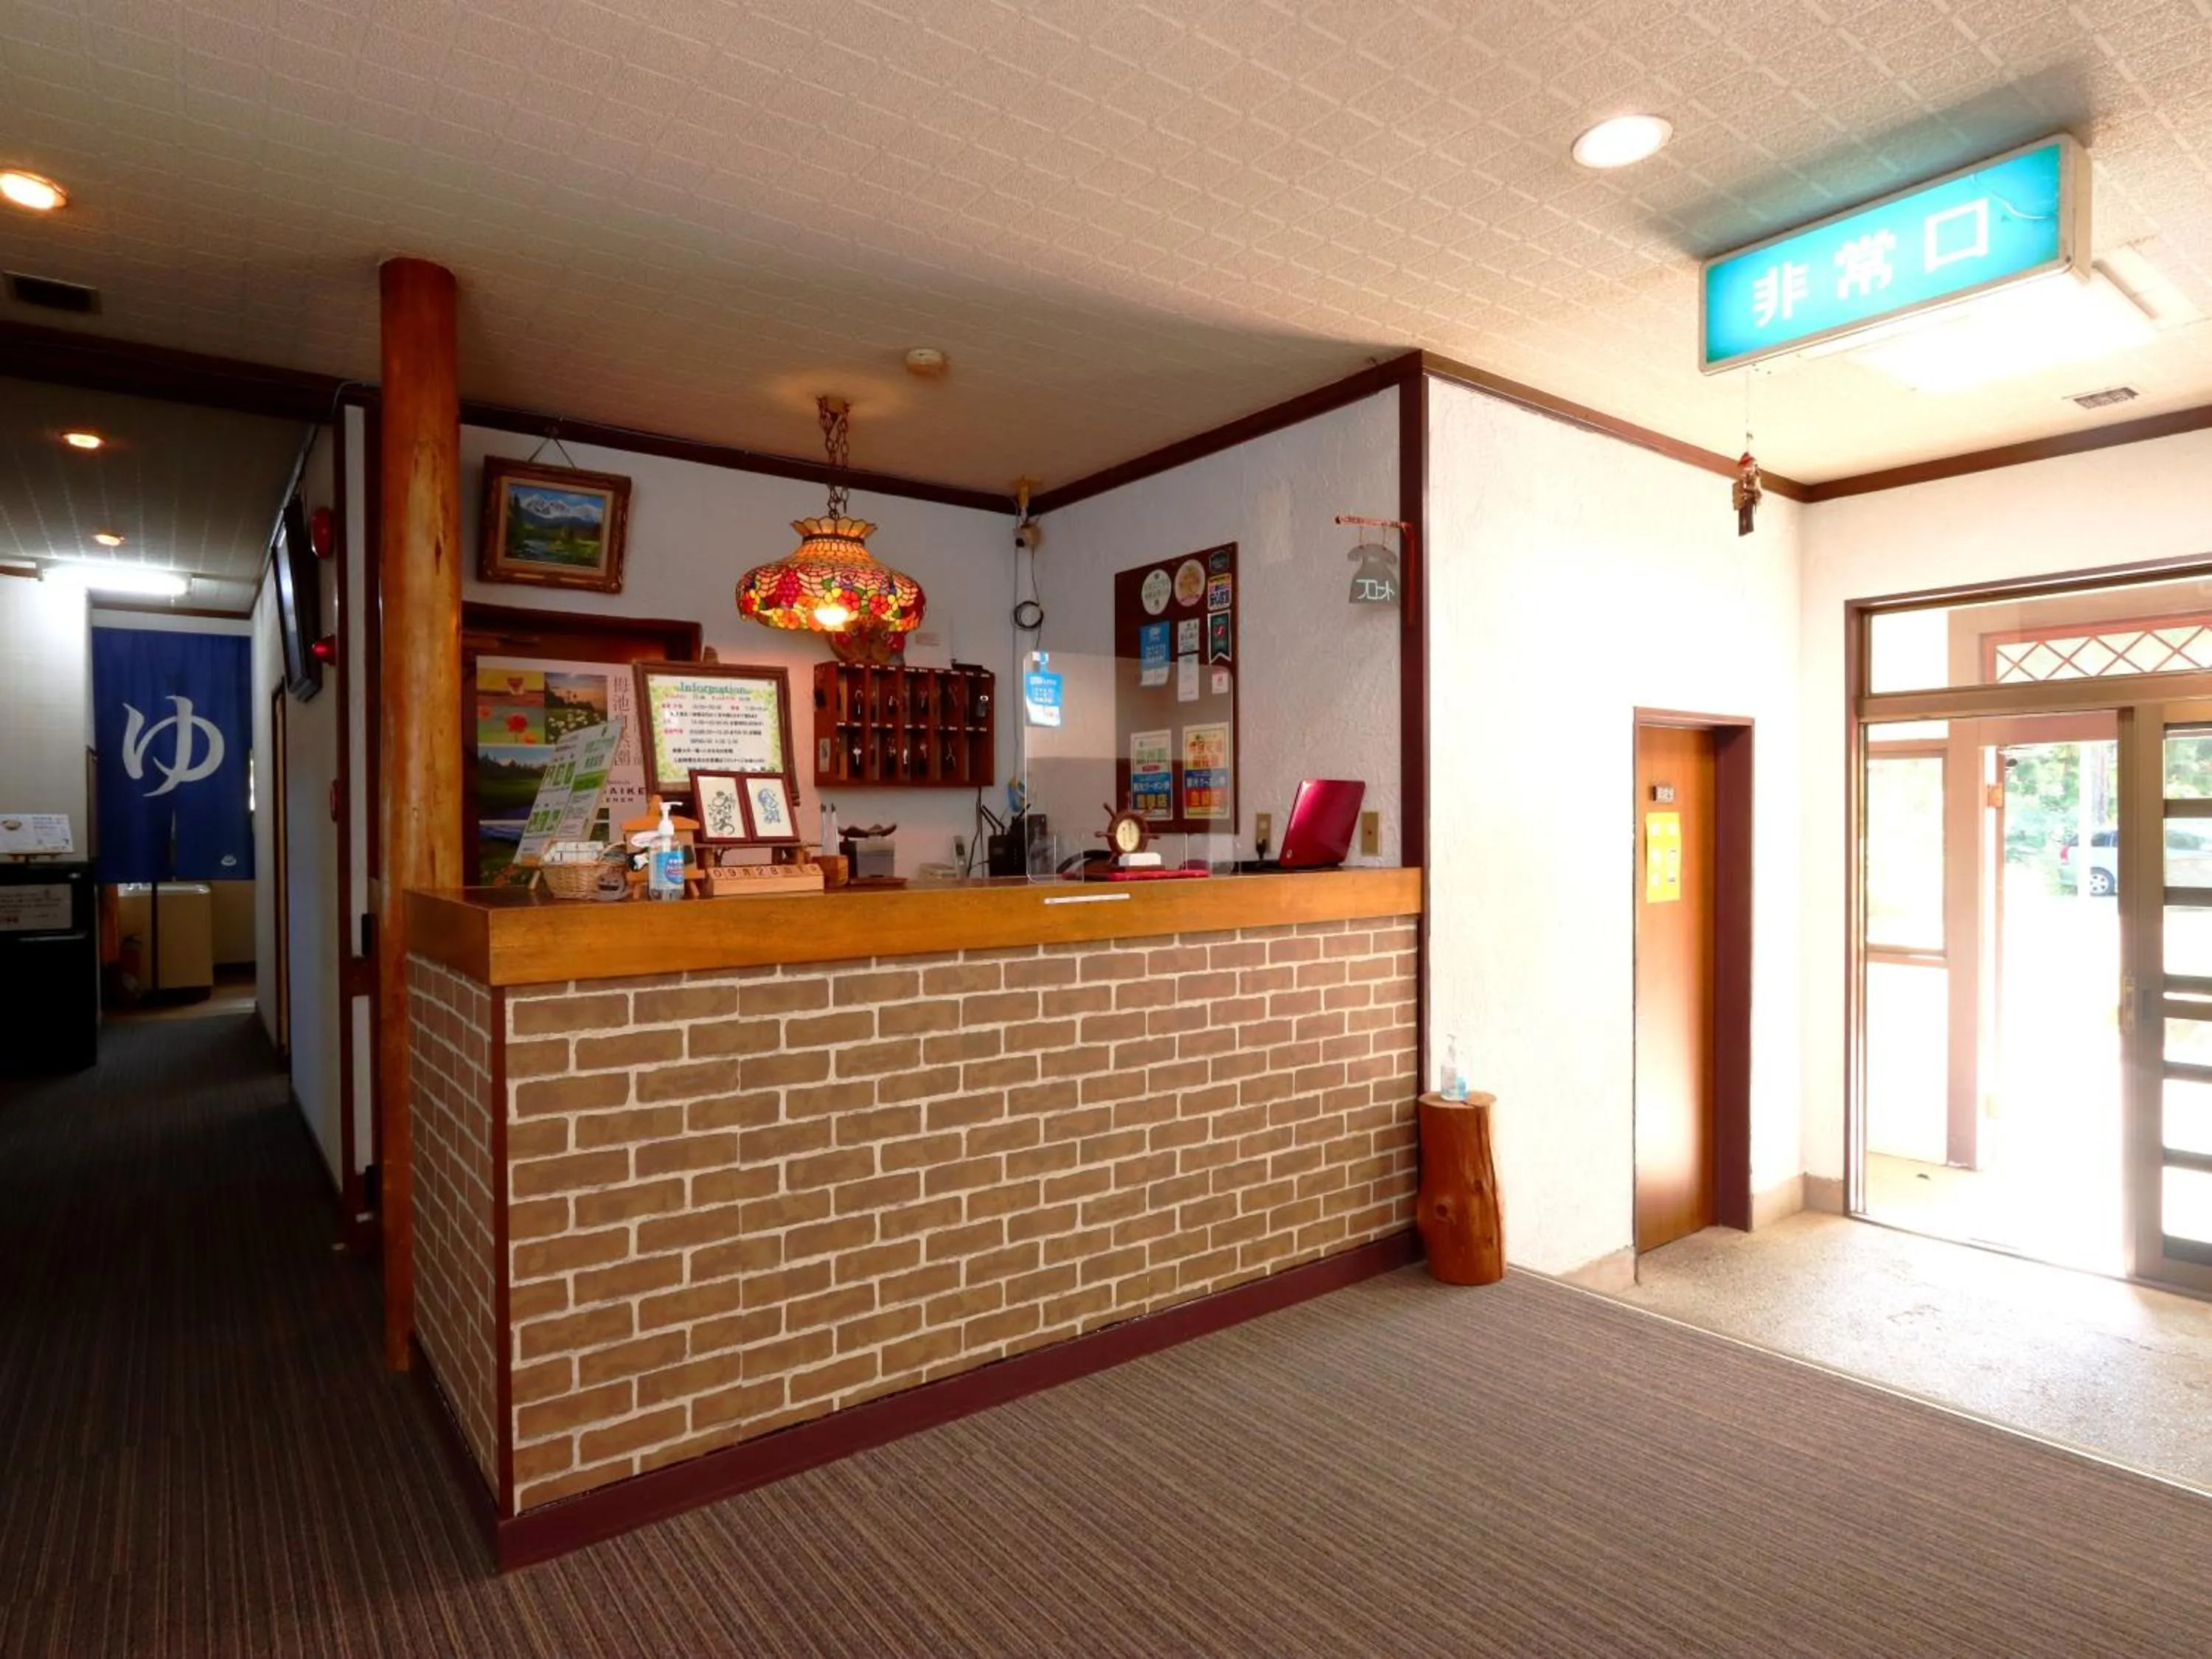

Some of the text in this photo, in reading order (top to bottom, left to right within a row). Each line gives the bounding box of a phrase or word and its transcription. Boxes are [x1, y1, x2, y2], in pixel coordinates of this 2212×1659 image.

[1752, 198, 1989, 328] 非常口
[122, 695, 226, 798] ゆ
[603, 787, 646, 795] AIKE
